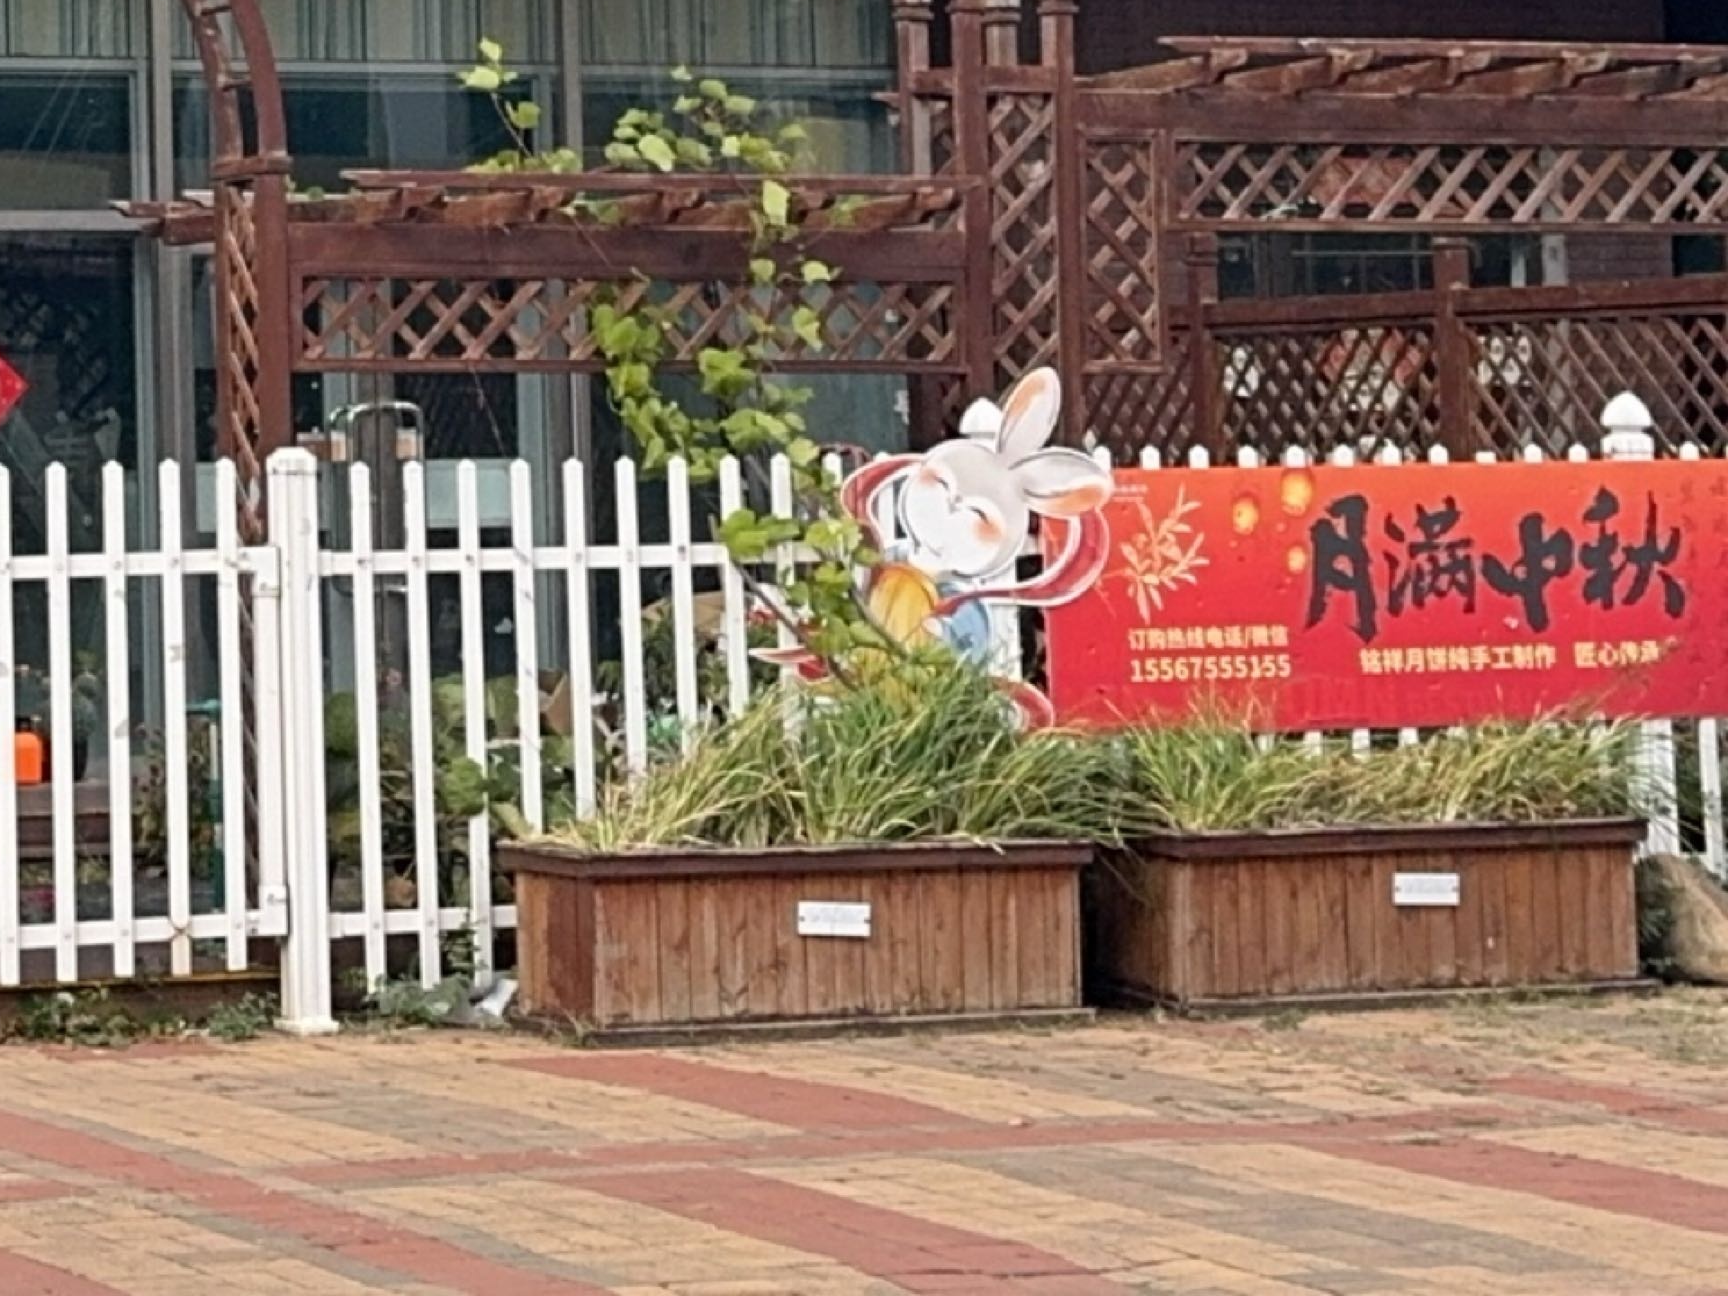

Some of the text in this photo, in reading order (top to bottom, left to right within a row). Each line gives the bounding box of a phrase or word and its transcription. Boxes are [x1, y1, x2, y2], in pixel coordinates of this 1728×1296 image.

[1305, 485, 1686, 644] 月满中秋
[1130, 654, 1291, 683] 15567555155
[1359, 642, 1557, 675] 铭祥月饼纯手工制作
